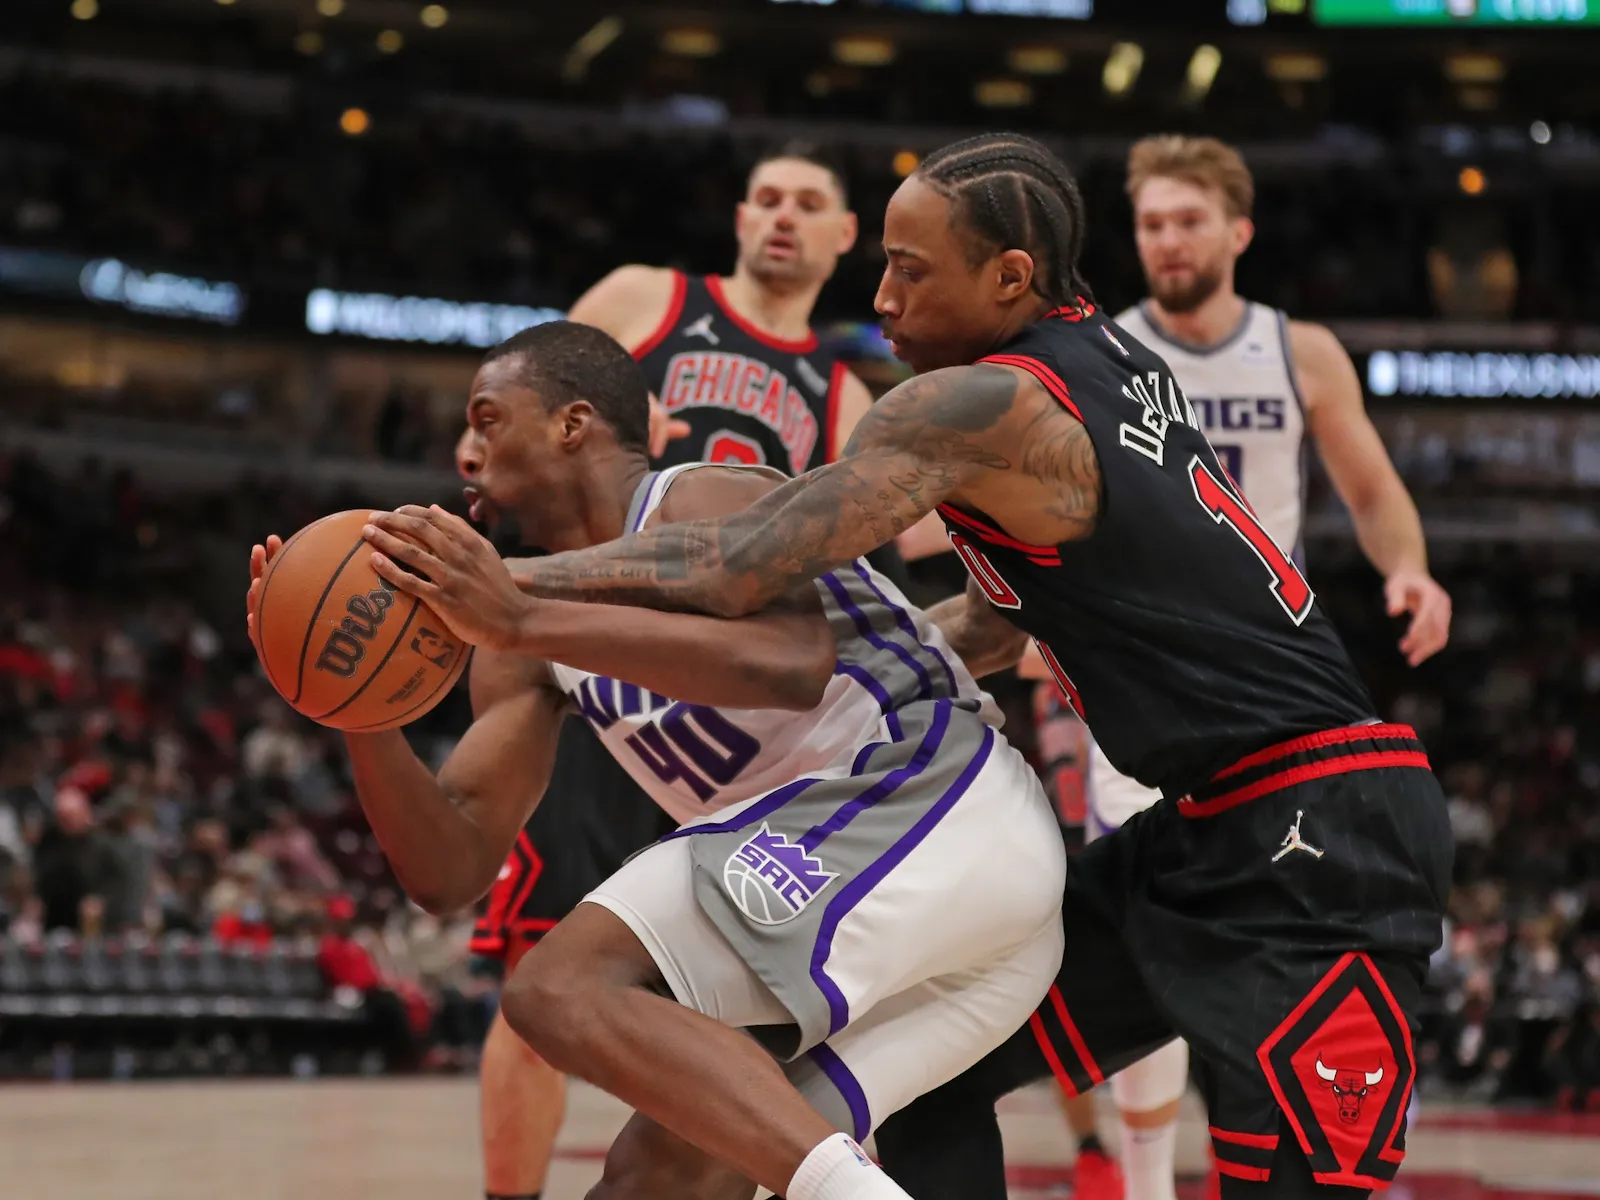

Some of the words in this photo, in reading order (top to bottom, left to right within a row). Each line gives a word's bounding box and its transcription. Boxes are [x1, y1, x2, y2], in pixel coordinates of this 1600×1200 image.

[660, 351, 818, 477] CHICAGO
[624, 700, 761, 804] 40
[734, 843, 811, 912] SAC
